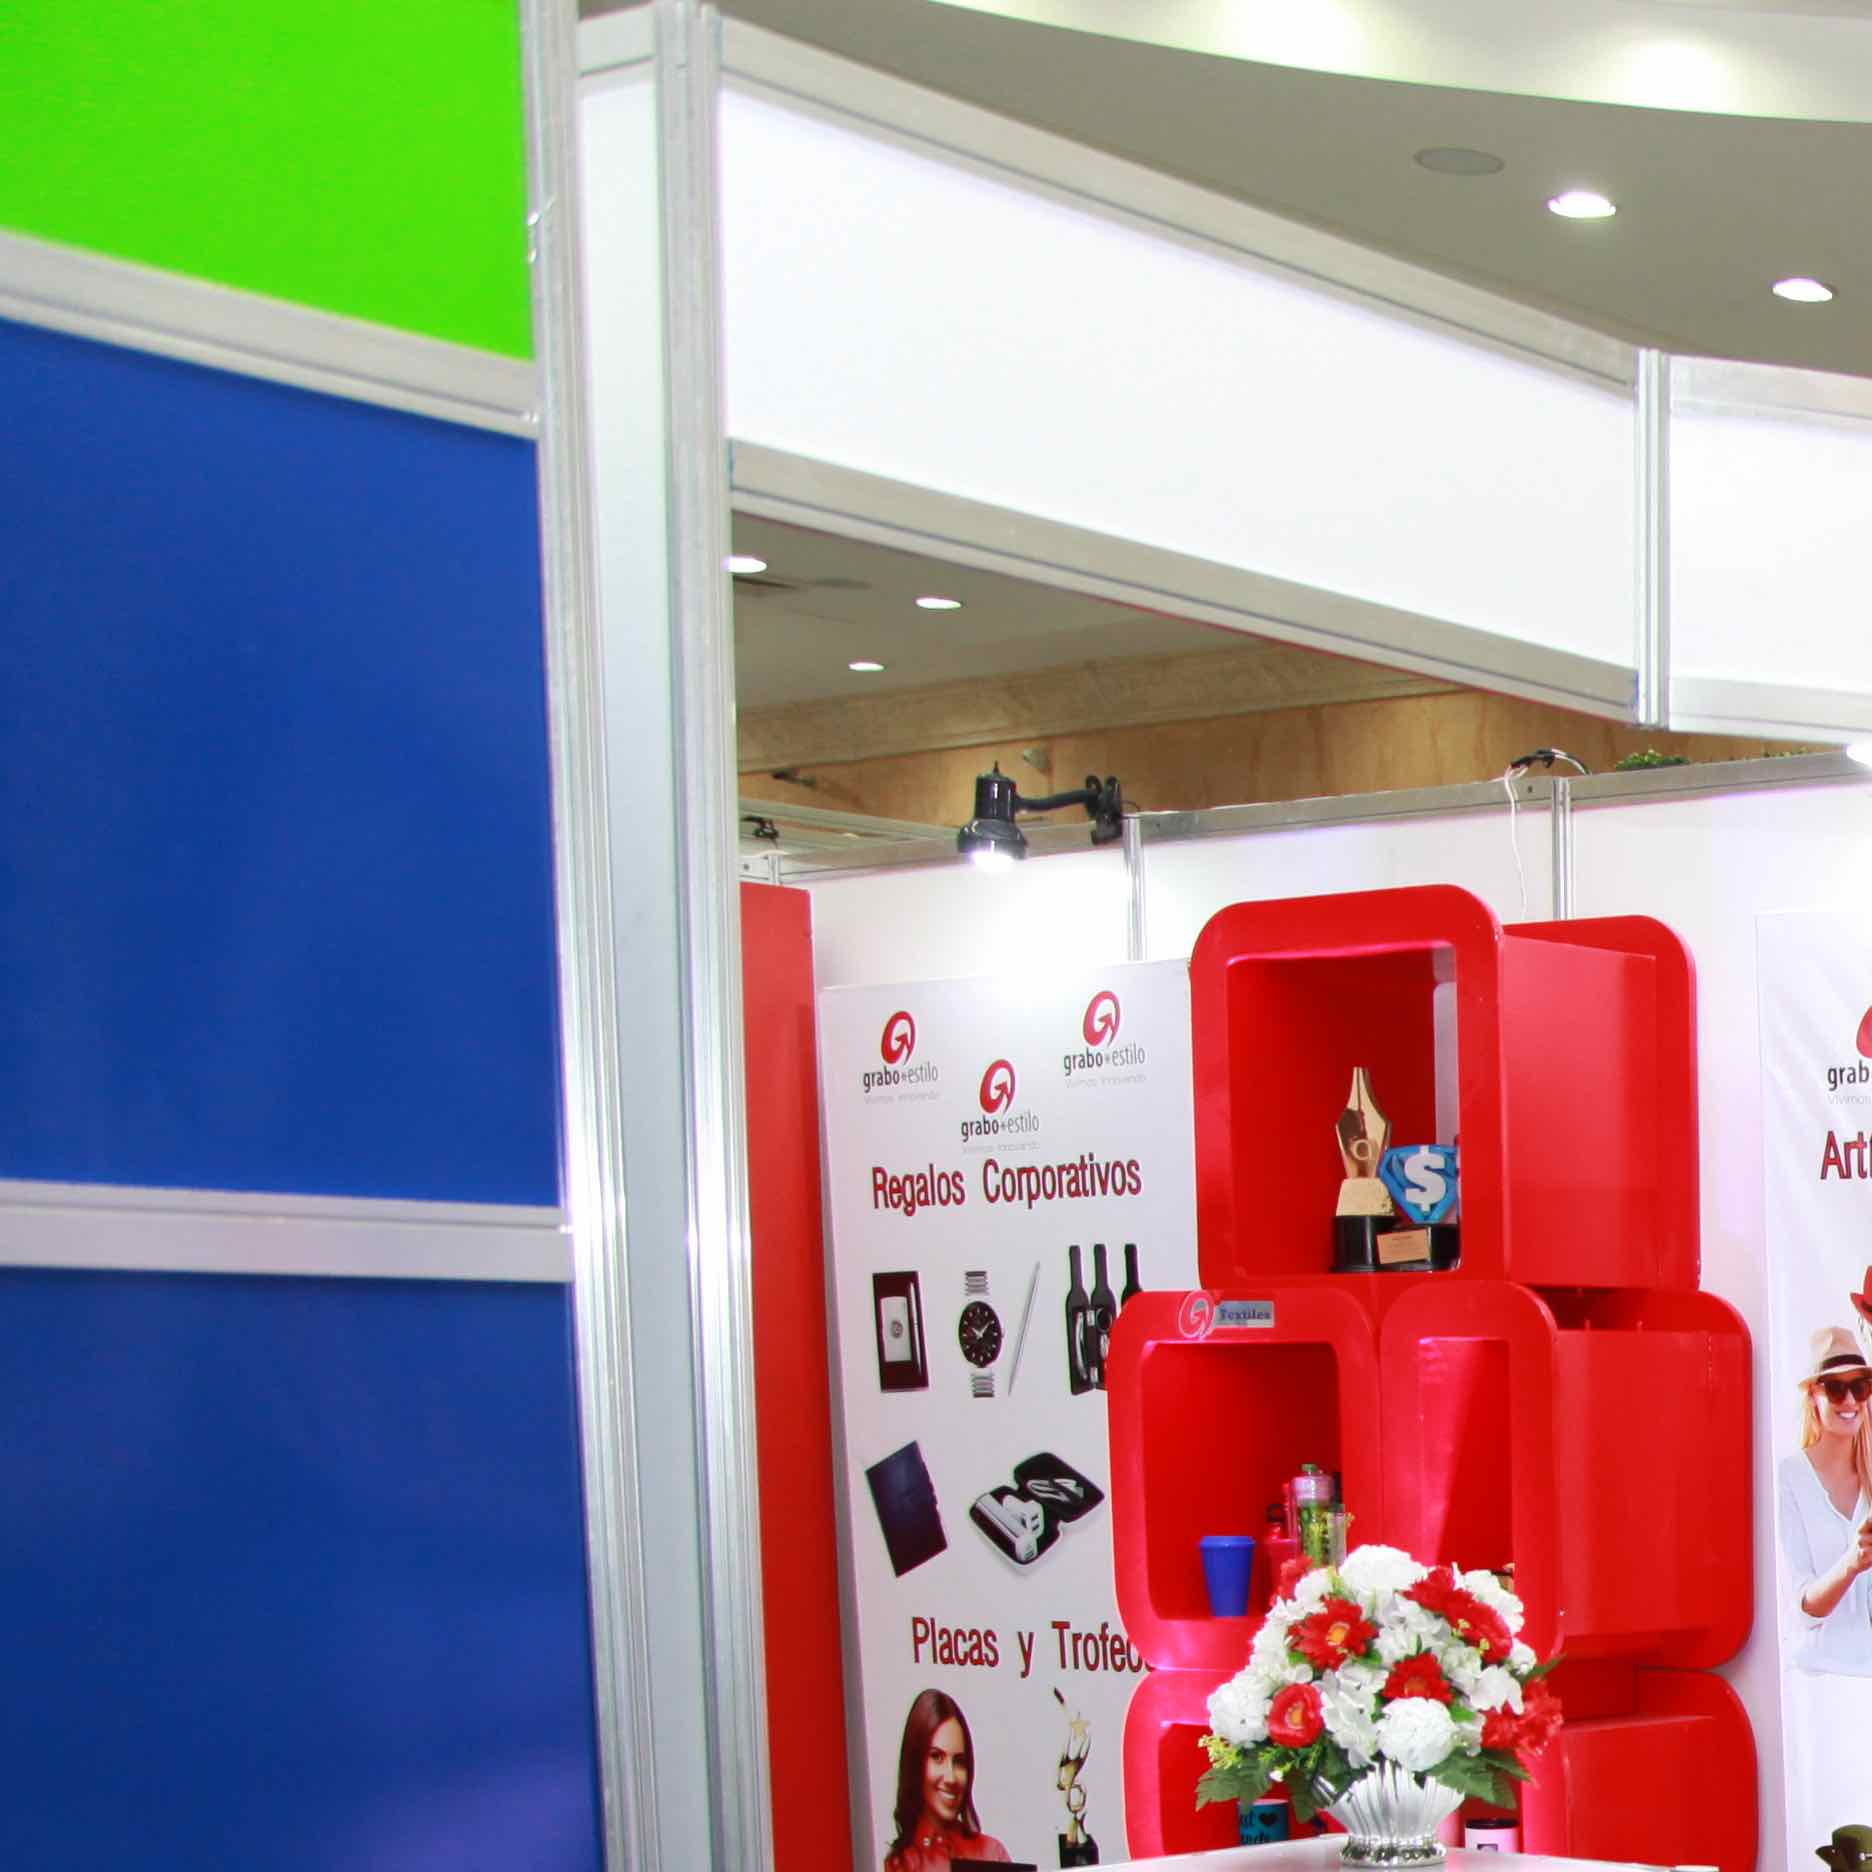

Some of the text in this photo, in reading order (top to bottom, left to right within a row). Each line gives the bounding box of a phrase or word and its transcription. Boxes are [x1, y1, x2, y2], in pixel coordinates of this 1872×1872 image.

[872, 1153, 1142, 1216] Regalos Corporativos
[912, 1616, 1153, 1678] Placas y Trofeo
